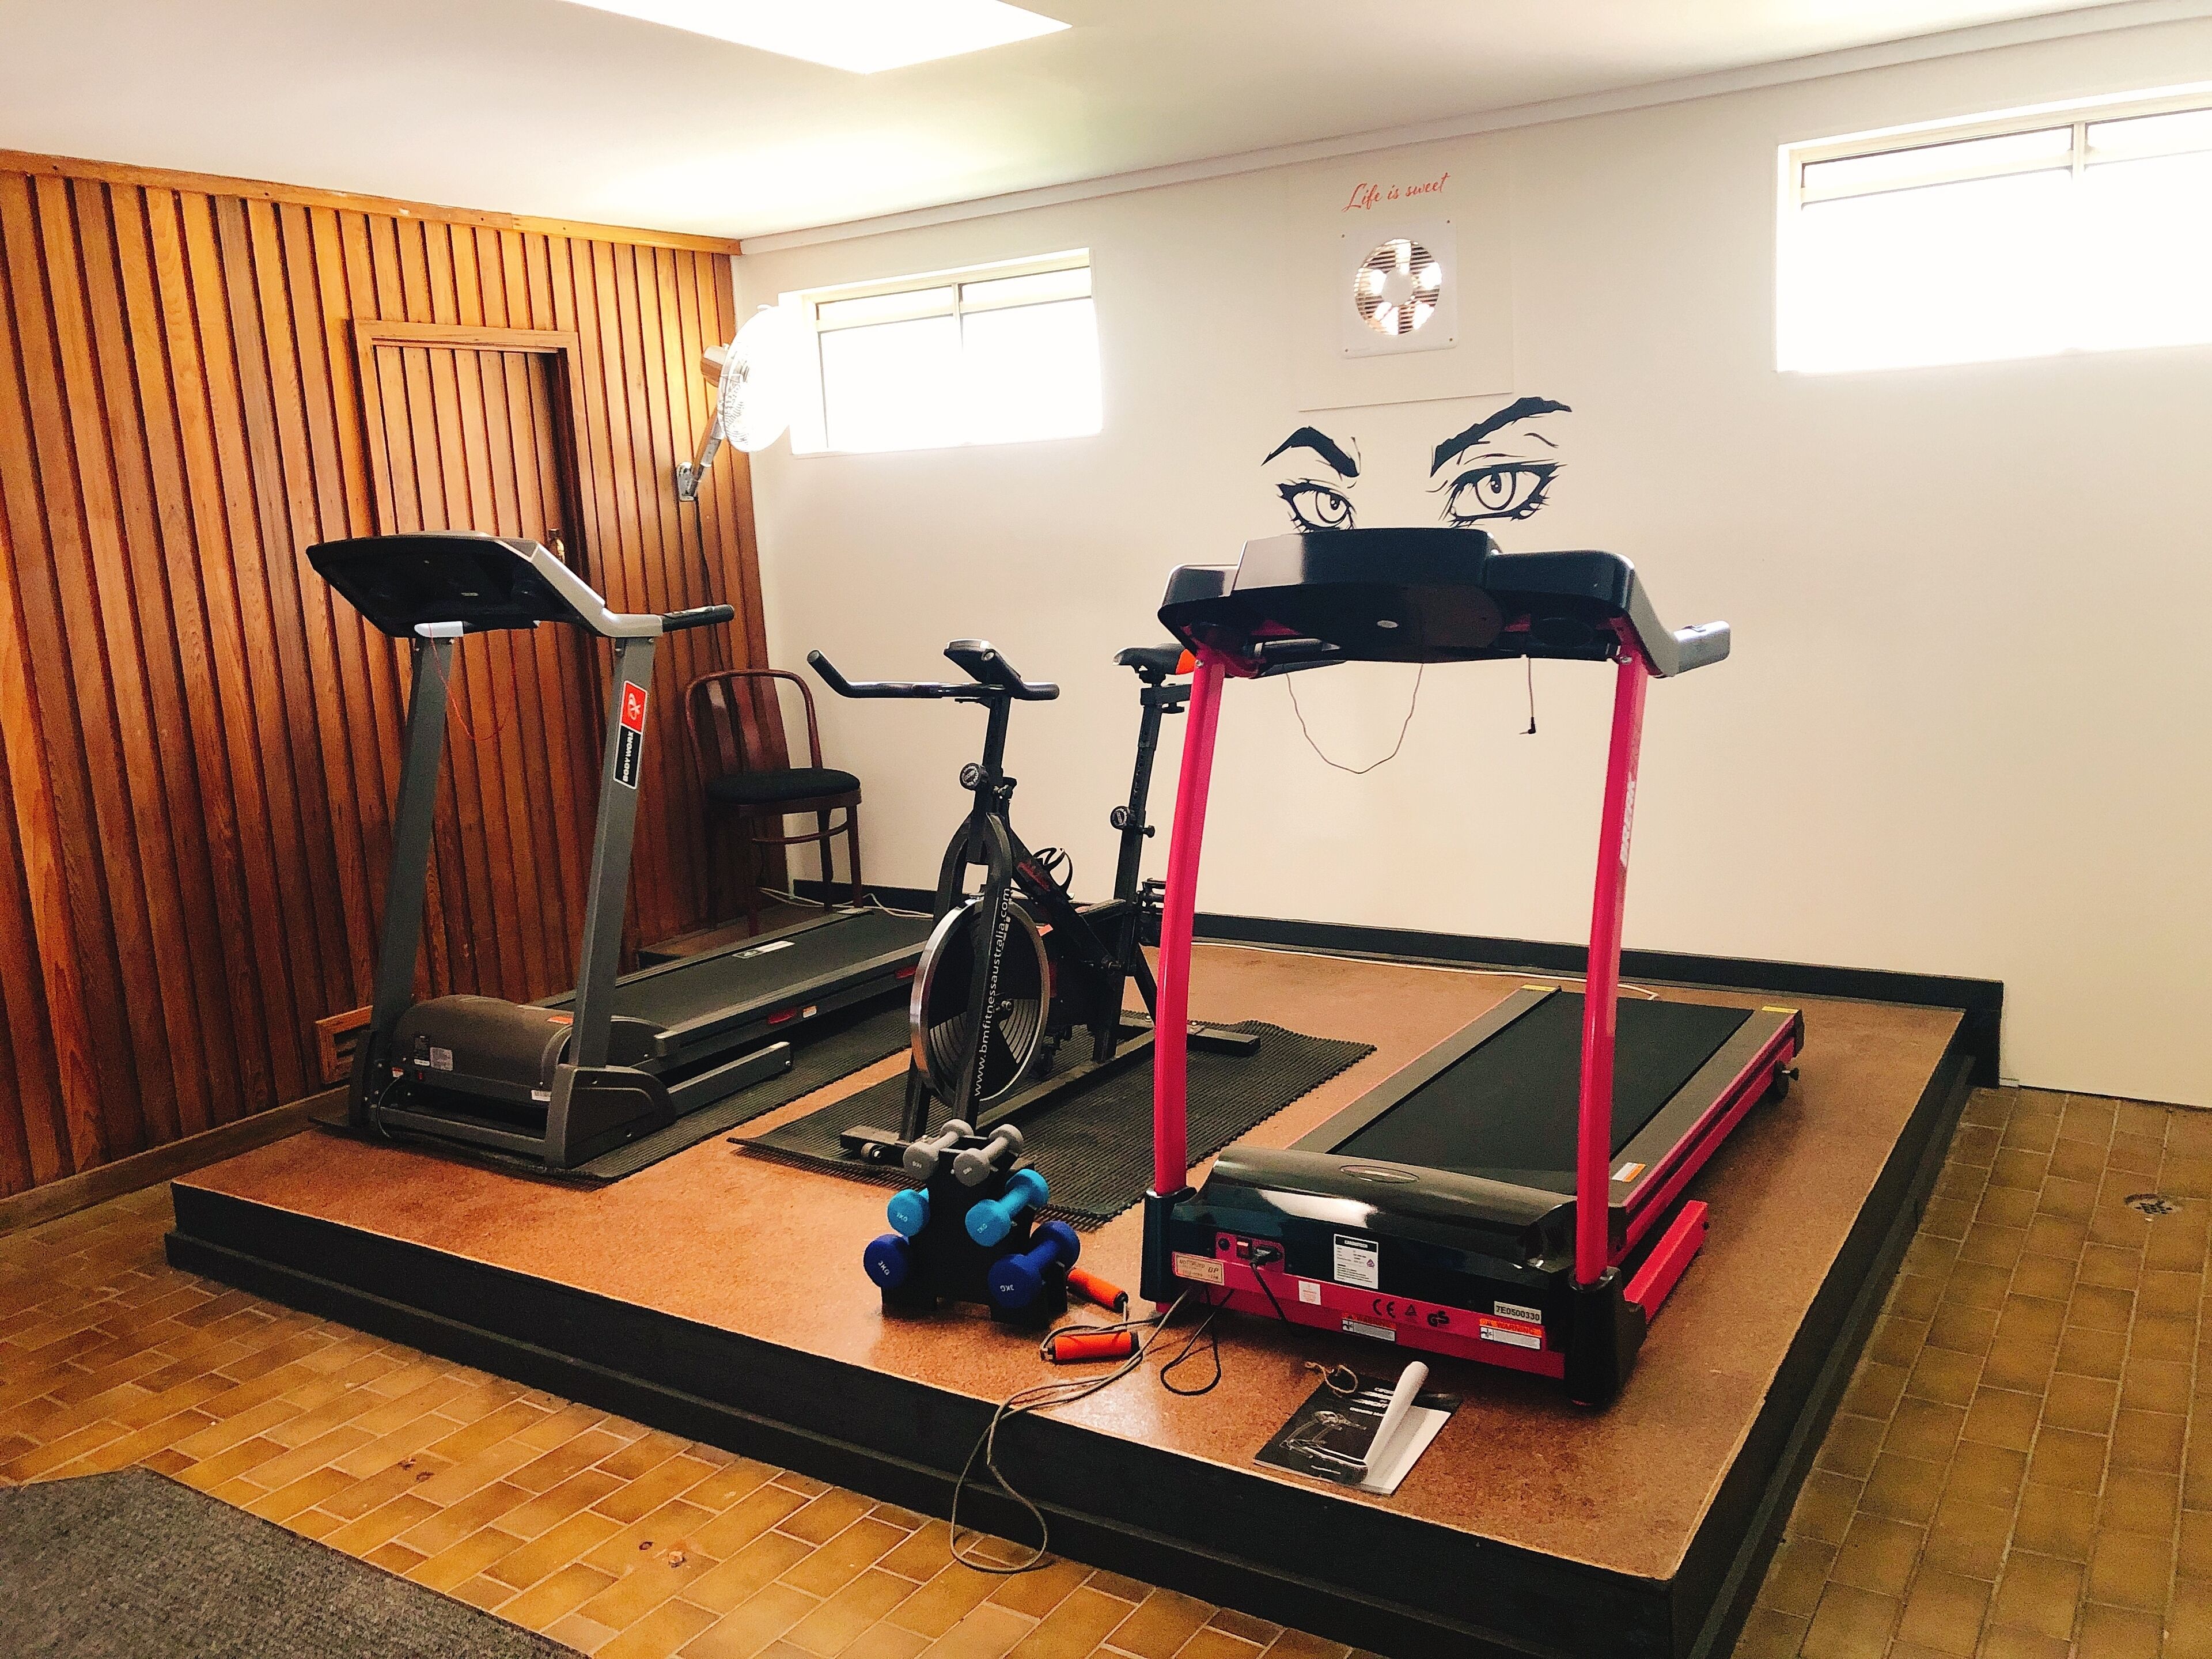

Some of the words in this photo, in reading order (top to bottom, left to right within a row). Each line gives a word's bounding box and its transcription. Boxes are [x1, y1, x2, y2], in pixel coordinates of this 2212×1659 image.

[1341, 183, 1382, 212] Life
[1387, 185, 1400, 200] is
[1406, 172, 1450, 196] sweet
[975, 888, 1010, 1096] www.bmfitnessaustralia.com
[1427, 1310, 1450, 1327] GS
[1496, 1305, 1540, 1321] 7E0500330
